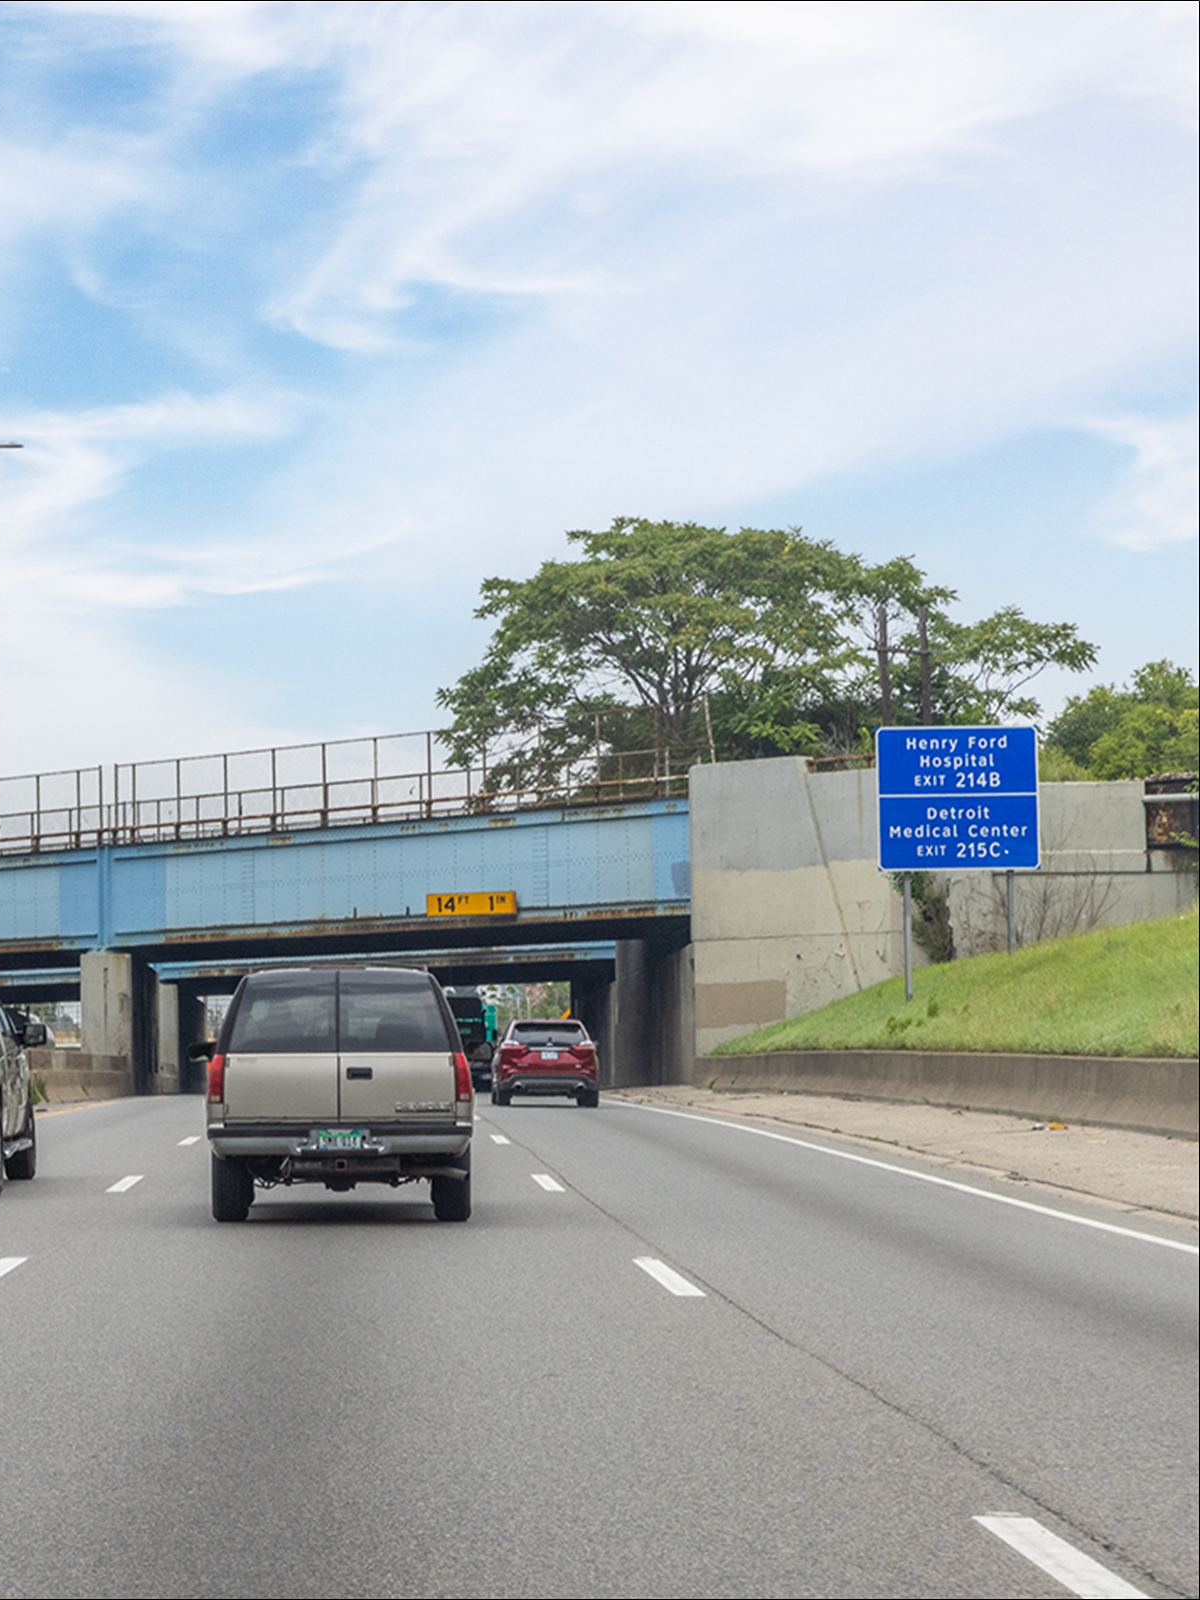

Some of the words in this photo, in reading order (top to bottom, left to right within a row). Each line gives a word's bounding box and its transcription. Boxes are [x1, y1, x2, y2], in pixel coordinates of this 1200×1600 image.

[906, 737, 958, 752] Henry
[968, 735, 1008, 749] Ford
[920, 753, 995, 770] Hospital
[914, 774, 946, 787] EXIT
[956, 772, 1001, 788] 214B
[927, 805, 990, 820] Detroit
[889, 824, 958, 838] Medical
[968, 824, 1028, 837] Center
[916, 845, 946, 857] EXIT
